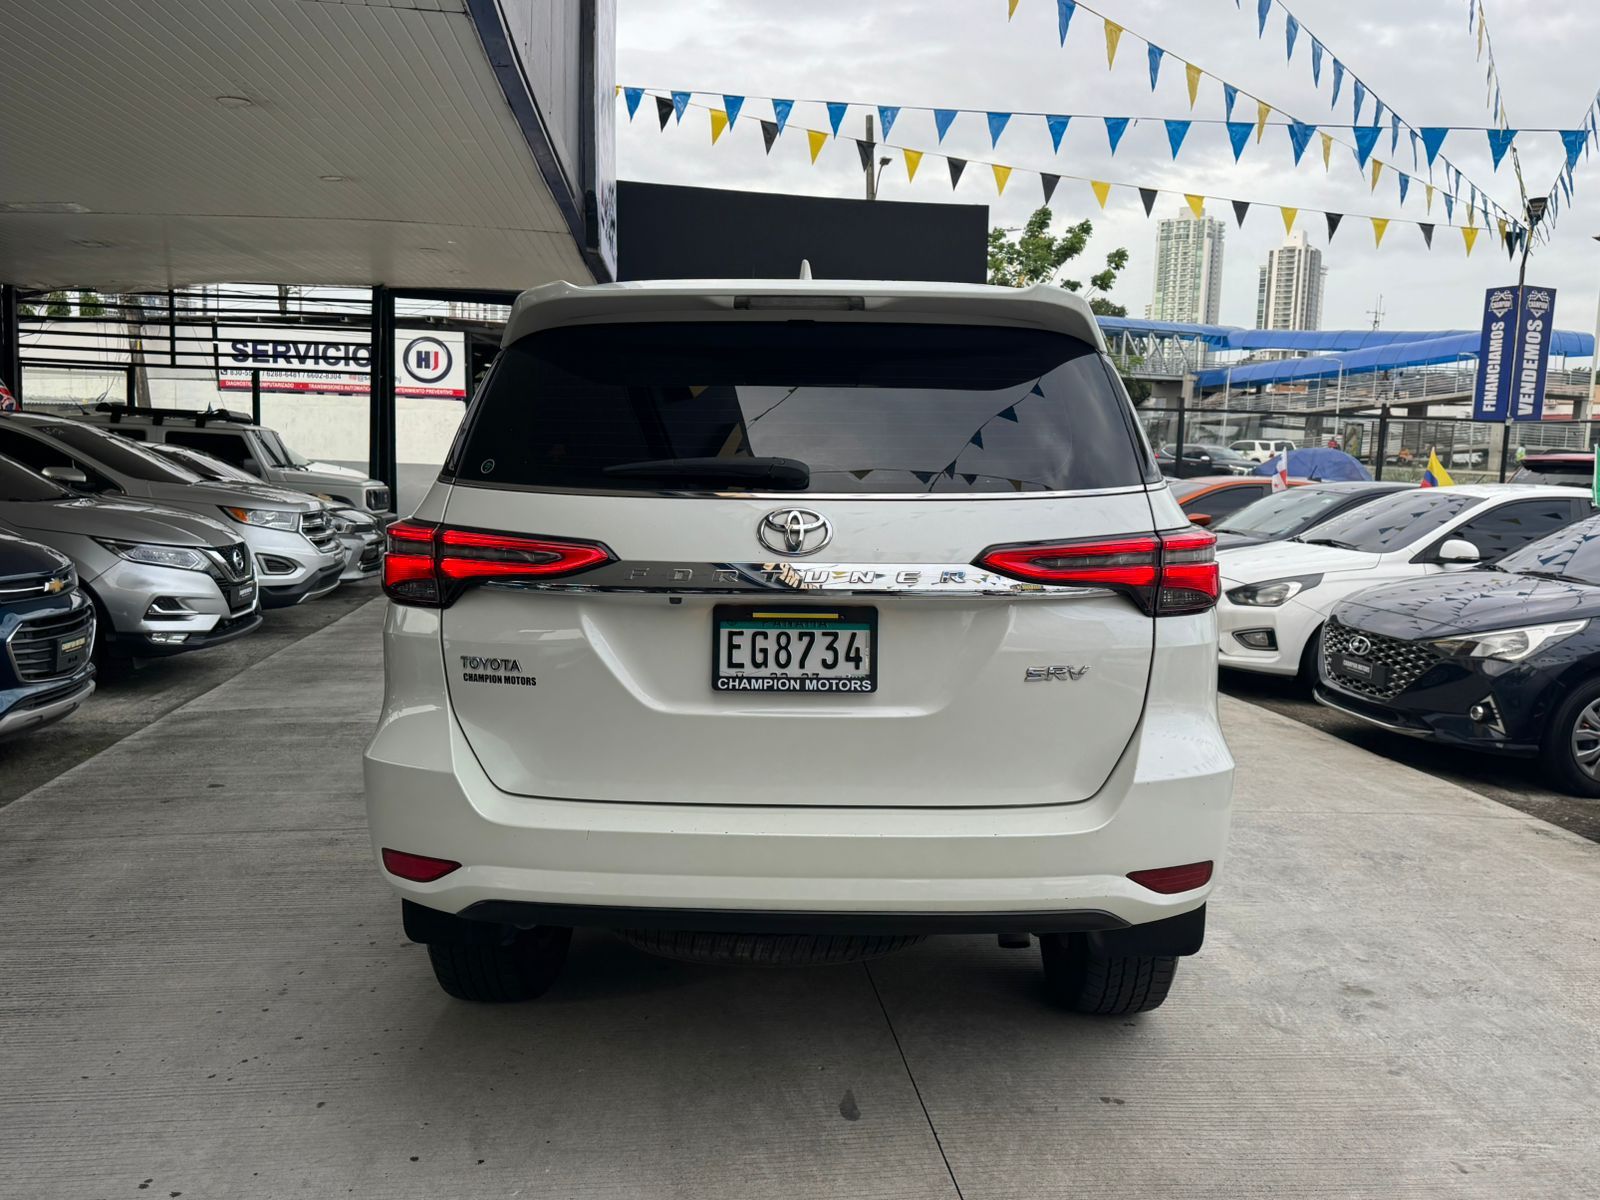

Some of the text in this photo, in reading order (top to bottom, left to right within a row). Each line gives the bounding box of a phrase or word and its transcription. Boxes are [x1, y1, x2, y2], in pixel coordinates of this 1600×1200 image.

[416, 350, 439, 371] HJ
[1482, 321, 1505, 412] FINANCIAMOS
[1517, 319, 1543, 416] VENDEMOS
[623, 568, 967, 584] FORTUNER
[727, 630, 863, 671] EG8734
[460, 655, 522, 673] TOYOTA
[1024, 664, 1092, 682] SRV
[463, 672, 537, 687] CHAMPION MOTORS
[717, 678, 872, 691] CHAMPION MOTORS
